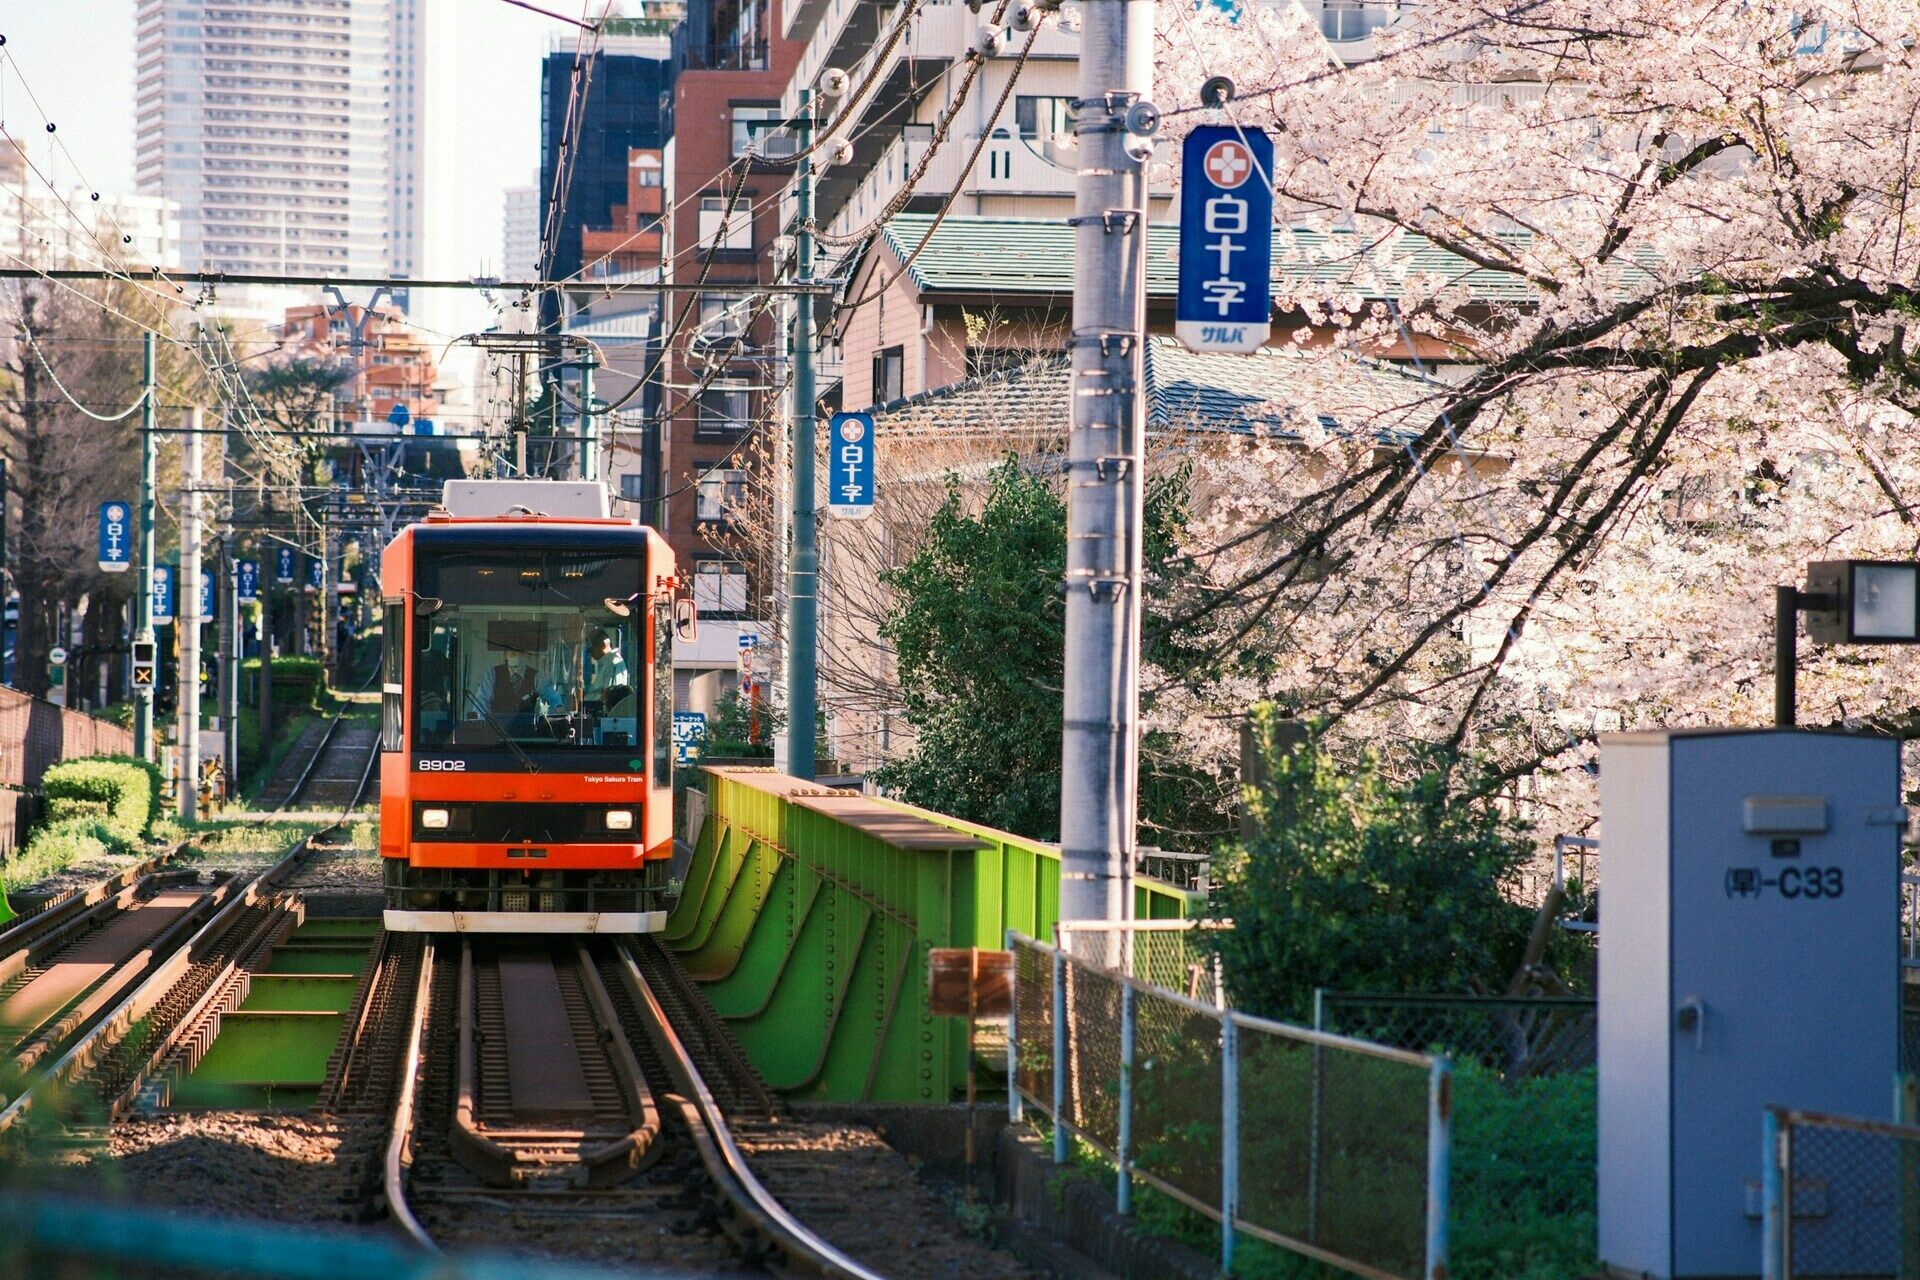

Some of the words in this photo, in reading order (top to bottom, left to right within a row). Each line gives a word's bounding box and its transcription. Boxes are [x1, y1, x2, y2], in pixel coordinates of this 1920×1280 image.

[1202, 193, 1249, 317] 白十字
[1200, 326, 1247, 344] サルバ
[841, 443, 863, 503] 白十字
[107, 522, 122, 561] 白十字
[154, 583, 167, 616] 白十字
[419, 759, 466, 771] 8902
[584, 776, 603, 784] Tokyo
